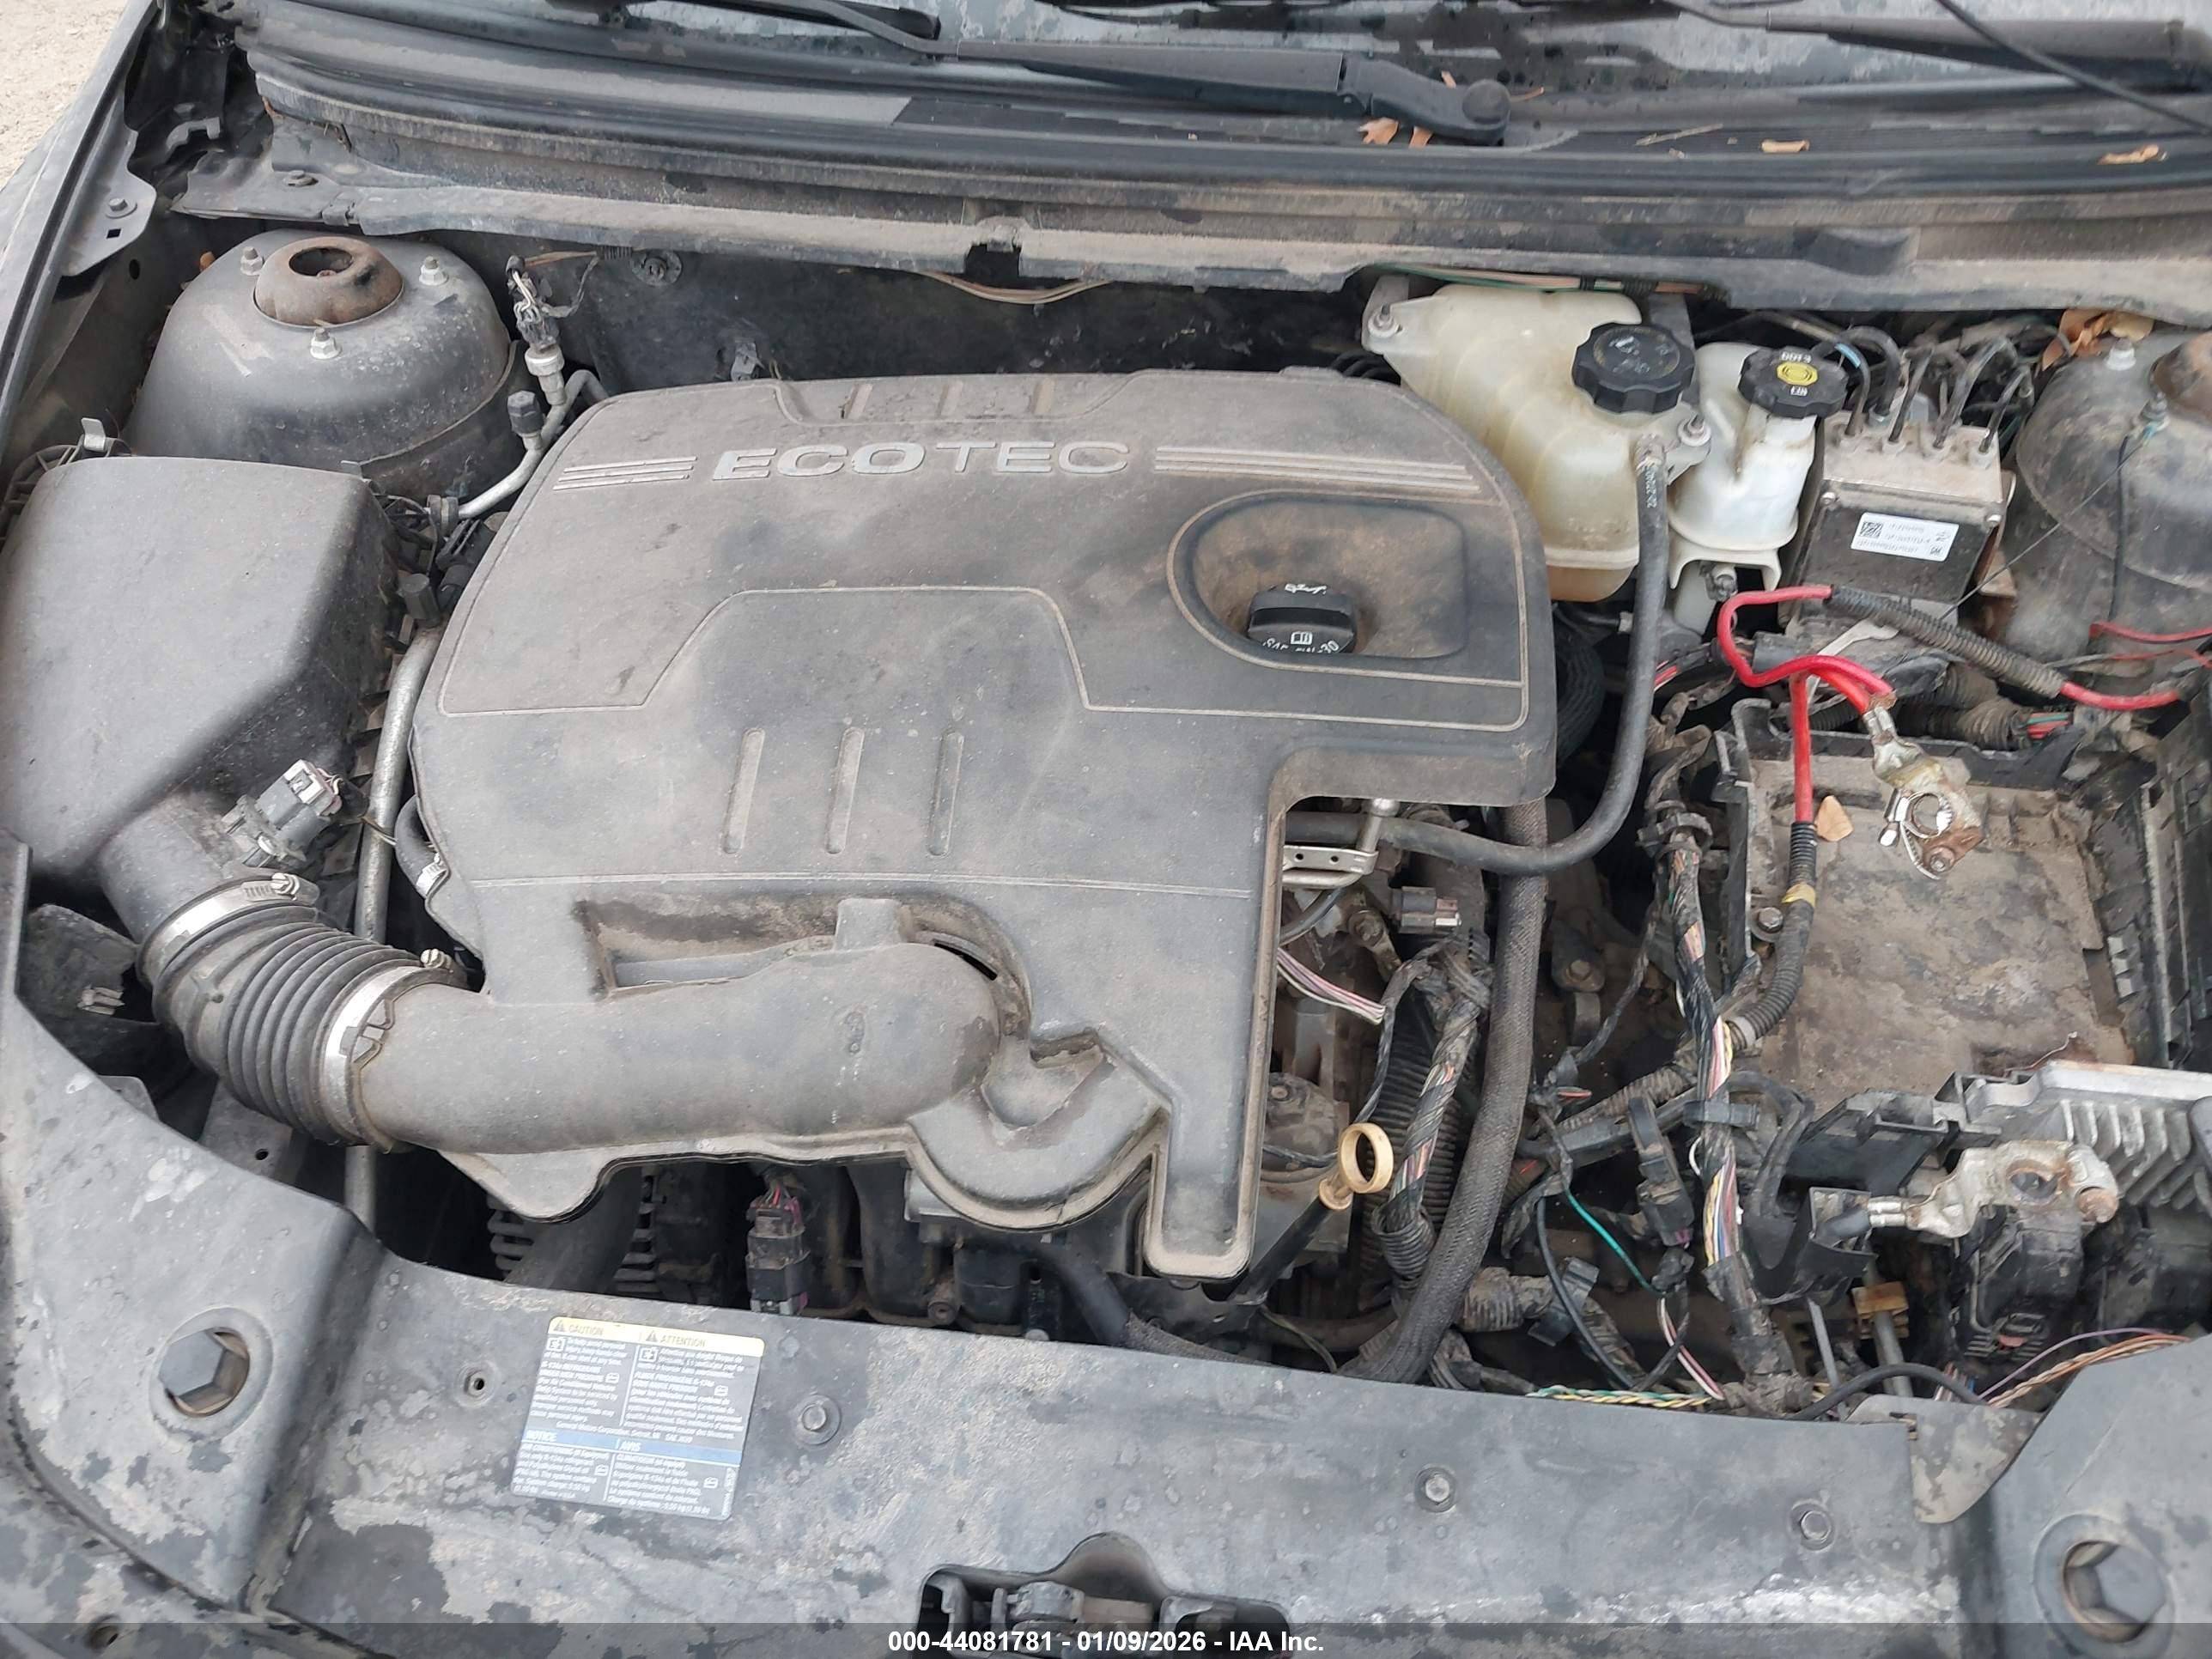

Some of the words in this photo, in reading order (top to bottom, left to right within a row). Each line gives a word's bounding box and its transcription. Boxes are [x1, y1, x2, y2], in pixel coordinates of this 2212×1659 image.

[712, 441, 1130, 481] ECOTEC
[568, 1322, 604, 1336] CAUTION
[659, 1334, 706, 1347] ATTENTION
